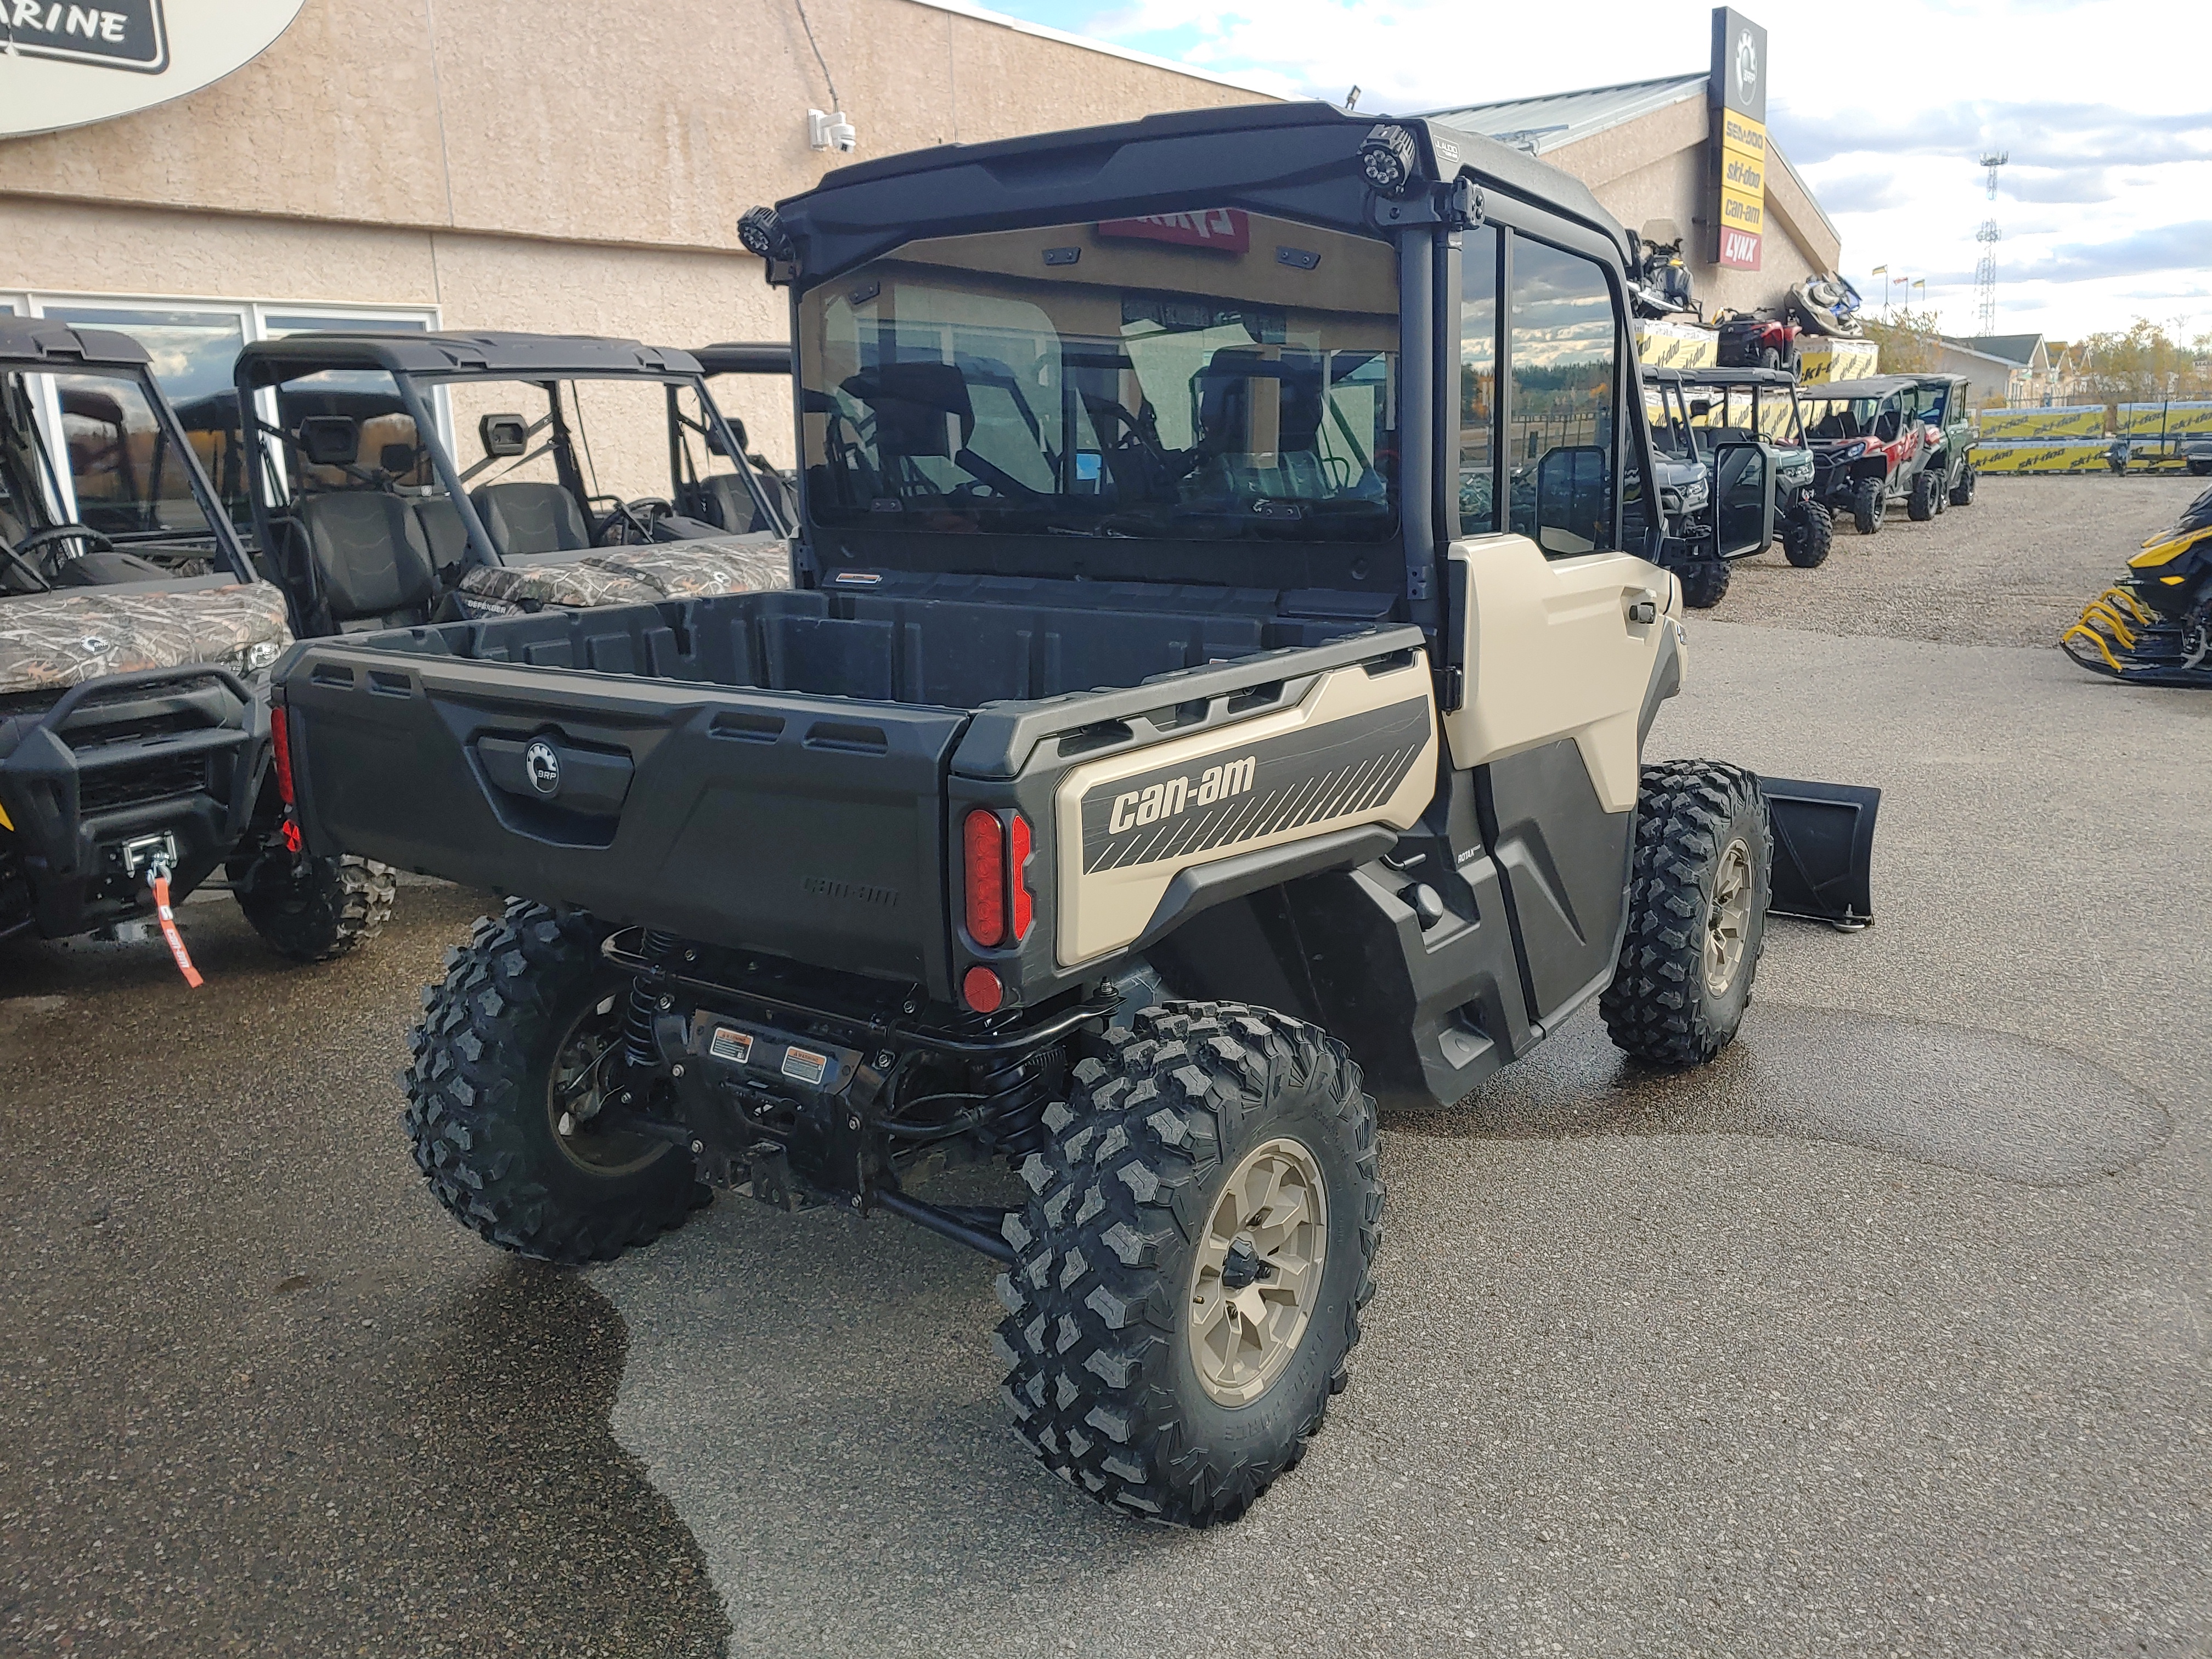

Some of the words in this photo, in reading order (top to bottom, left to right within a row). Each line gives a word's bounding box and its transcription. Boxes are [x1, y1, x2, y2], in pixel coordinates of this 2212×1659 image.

[1726, 160, 1761, 189] ski-doo
[1725, 199, 1760, 224] can-am
[1725, 233, 1757, 263] LYNX
[1655, 339, 1680, 368] ki-doo
[467, 600, 506, 614] DEFENDER
[538, 769, 556, 780] BRP
[1109, 755, 1256, 834] can-am
[1458, 848, 1474, 864] ROTAX
